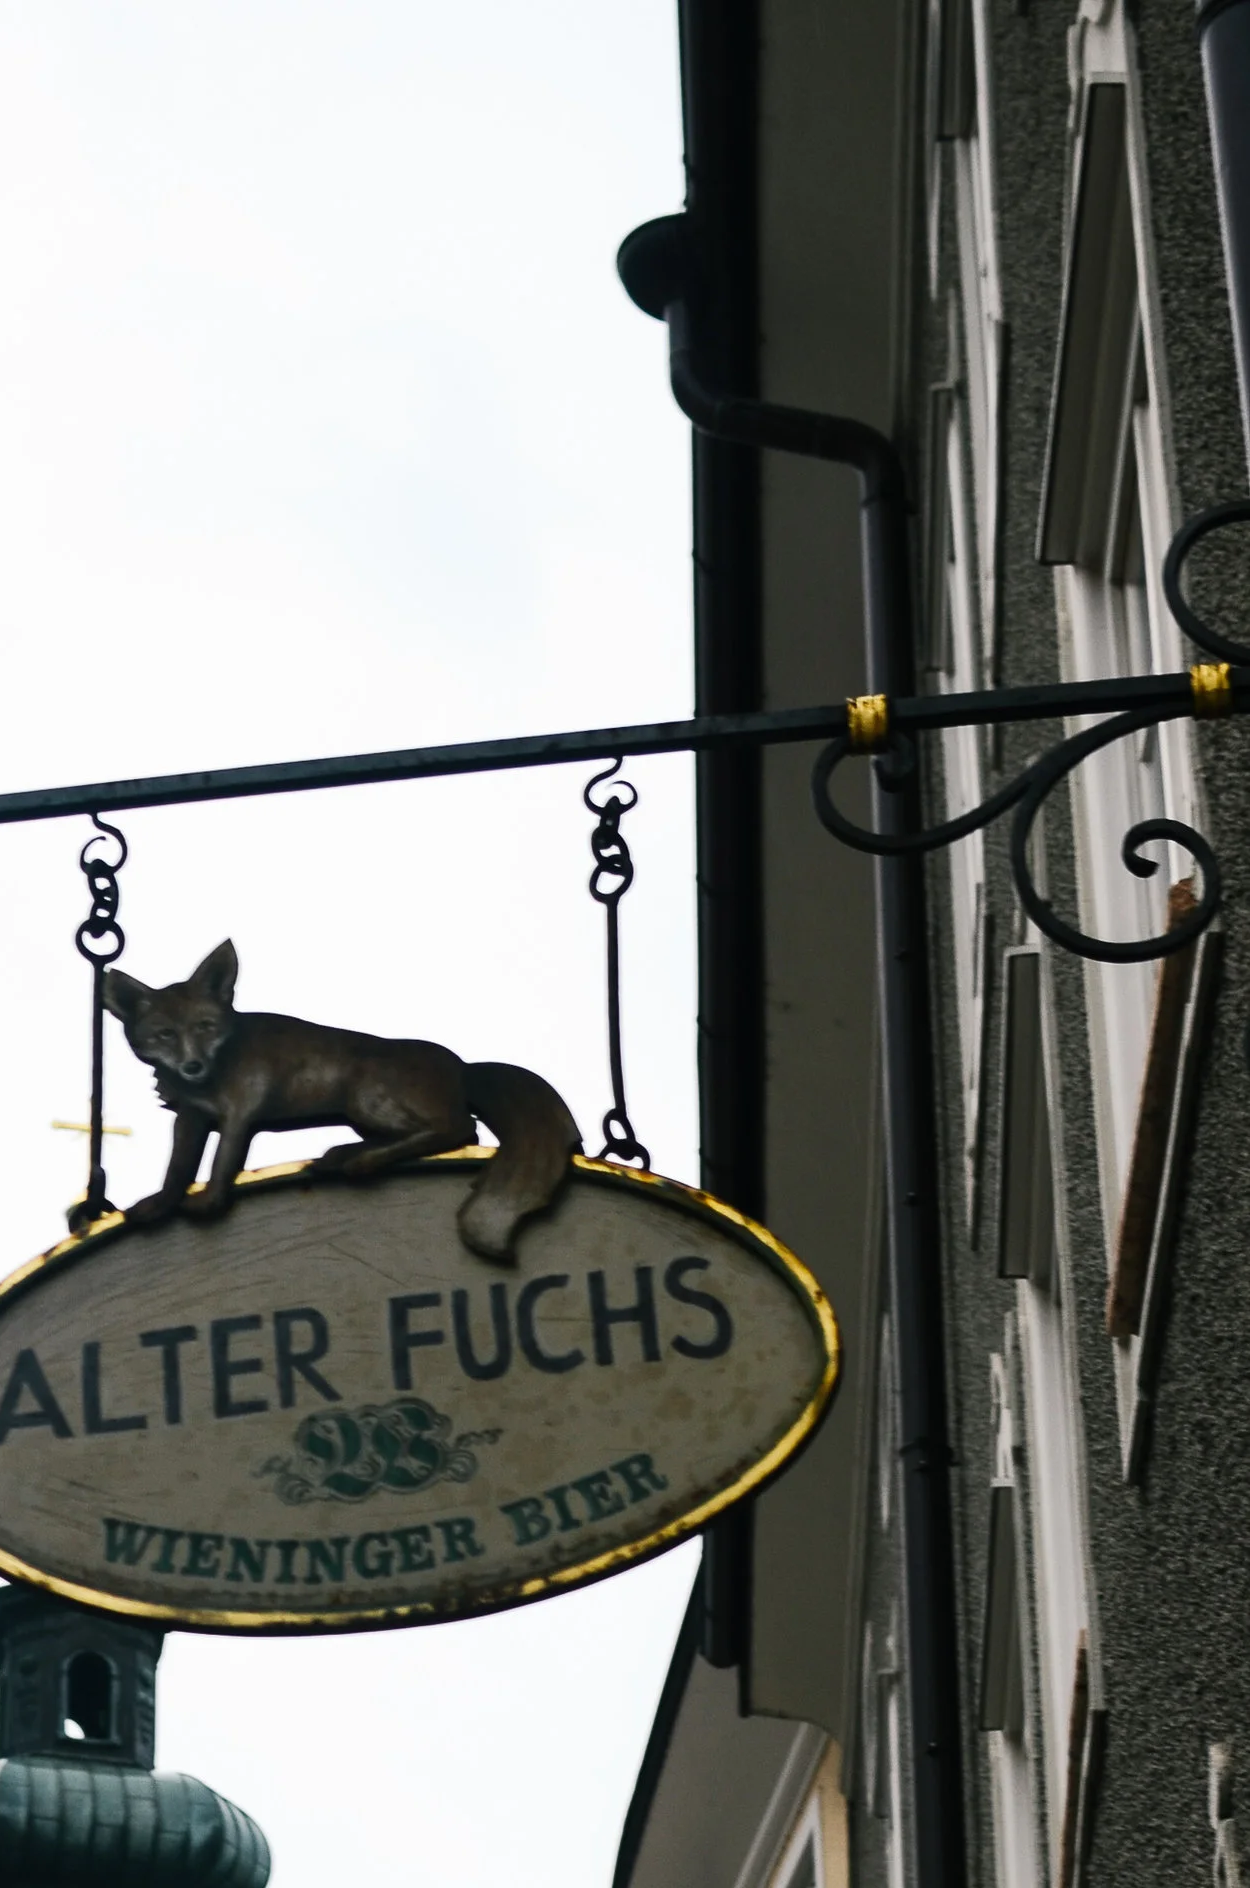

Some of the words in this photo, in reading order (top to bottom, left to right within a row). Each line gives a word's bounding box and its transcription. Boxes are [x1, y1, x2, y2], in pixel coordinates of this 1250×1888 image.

[388, 1255, 733, 1392] FUCHS
[101, 1515, 485, 1585] WIENINGER
[501, 1452, 669, 1548] BIER
